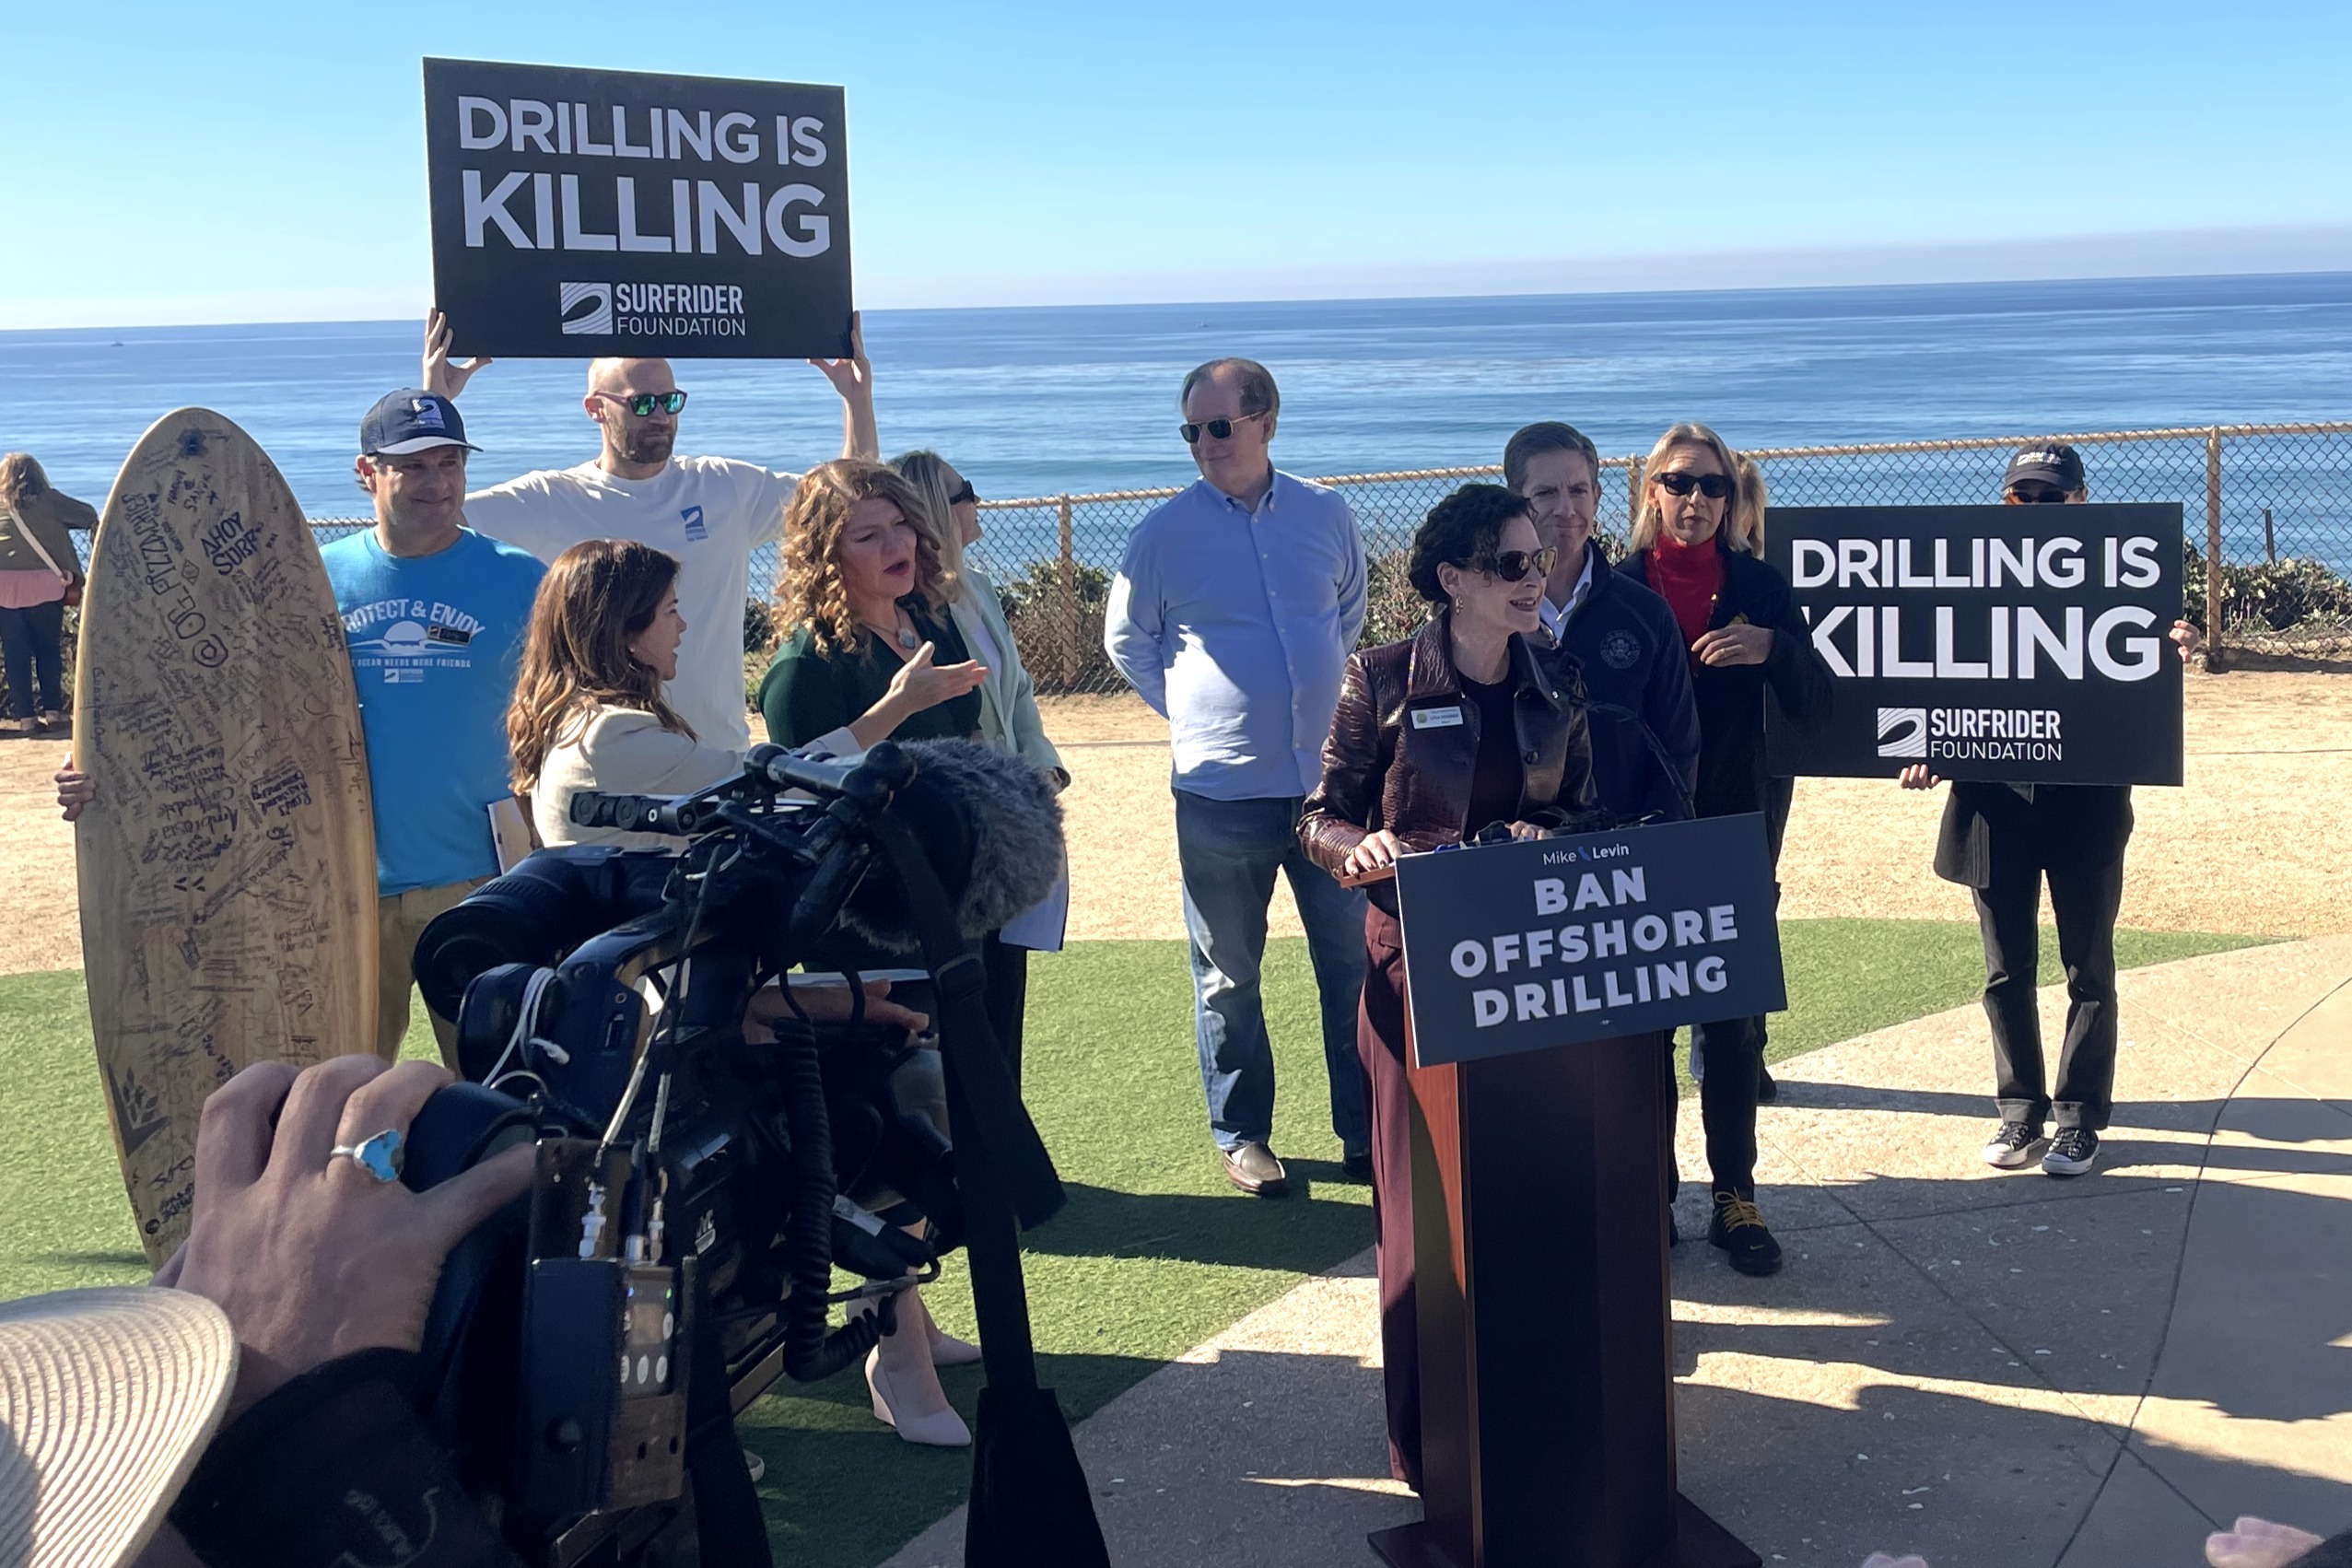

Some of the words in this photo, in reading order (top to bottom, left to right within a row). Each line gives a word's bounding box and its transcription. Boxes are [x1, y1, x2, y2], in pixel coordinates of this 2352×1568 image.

[458, 95, 760, 164] DRILLING
[775, 114, 827, 168] IS
[462, 169, 831, 258] KILLING
[615, 282, 744, 315] SURFRIDER
[616, 316, 747, 337] FOUNDATION
[200, 511, 246, 558] AHOY
[1791, 536, 2086, 590] DRILLING
[2104, 535, 2161, 590] IS
[341, 599, 410, 634] ROTECT
[410, 600, 427, 618] &
[430, 602, 486, 638] ENJOY
[437, 658, 472, 668] FRIENDS
[1801, 604, 2161, 683] KILLING
[1930, 708, 2062, 740] SURFRIDER
[1930, 741, 2063, 762] FOUNDATION
[1543, 850, 1577, 866] Mike
[1592, 842, 1630, 860] Levin
[1533, 866, 1648, 917] BAN
[1449, 903, 1739, 978] OFFSHORE
[1471, 955, 1728, 1029] DRILLING
